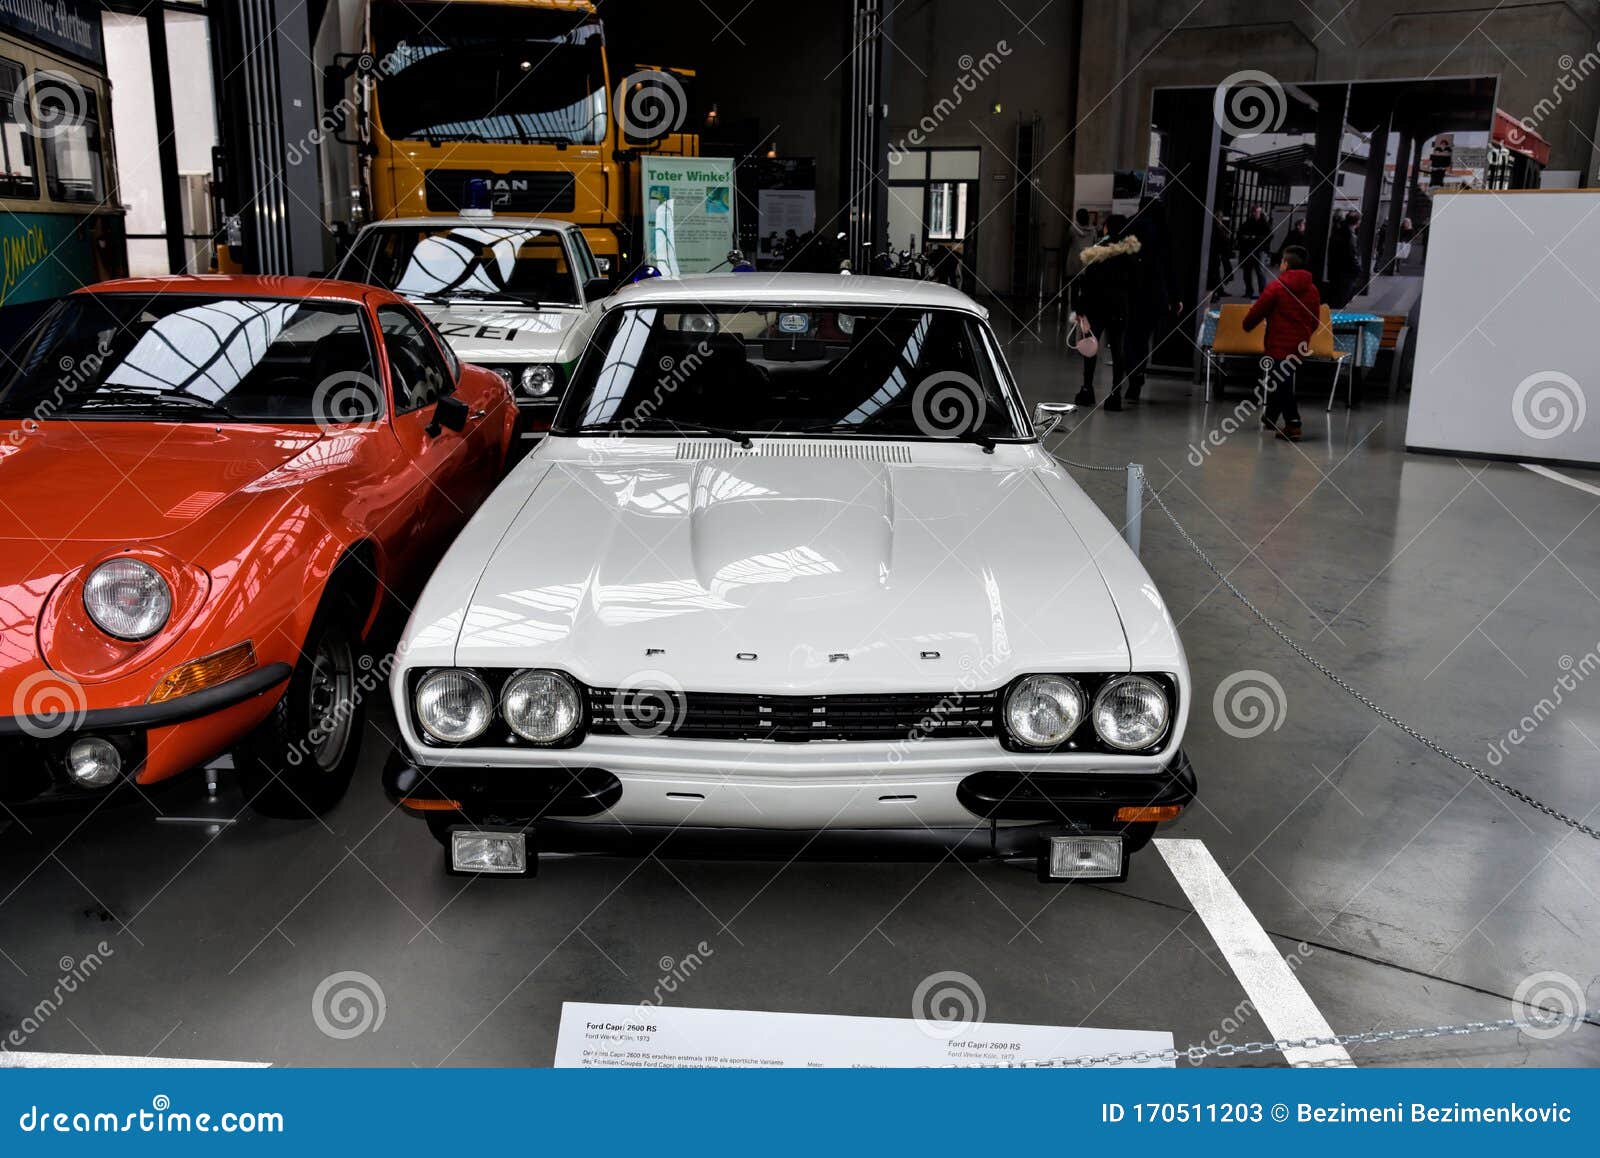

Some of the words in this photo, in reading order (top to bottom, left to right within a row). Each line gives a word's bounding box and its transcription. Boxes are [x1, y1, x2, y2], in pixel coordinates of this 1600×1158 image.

[648, 170, 683, 181] Toter
[586, 1022, 604, 1030] Ford
[606, 1023, 625, 1032] Capri
[948, 1040, 966, 1048] Ford
[967, 1041, 988, 1050] Capri
[990, 1042, 1008, 1050] 2600
[1009, 1043, 1021, 1051] RS
[729, 1057, 759, 1065] sportliche
[760, 1058, 784, 1066] Variante
